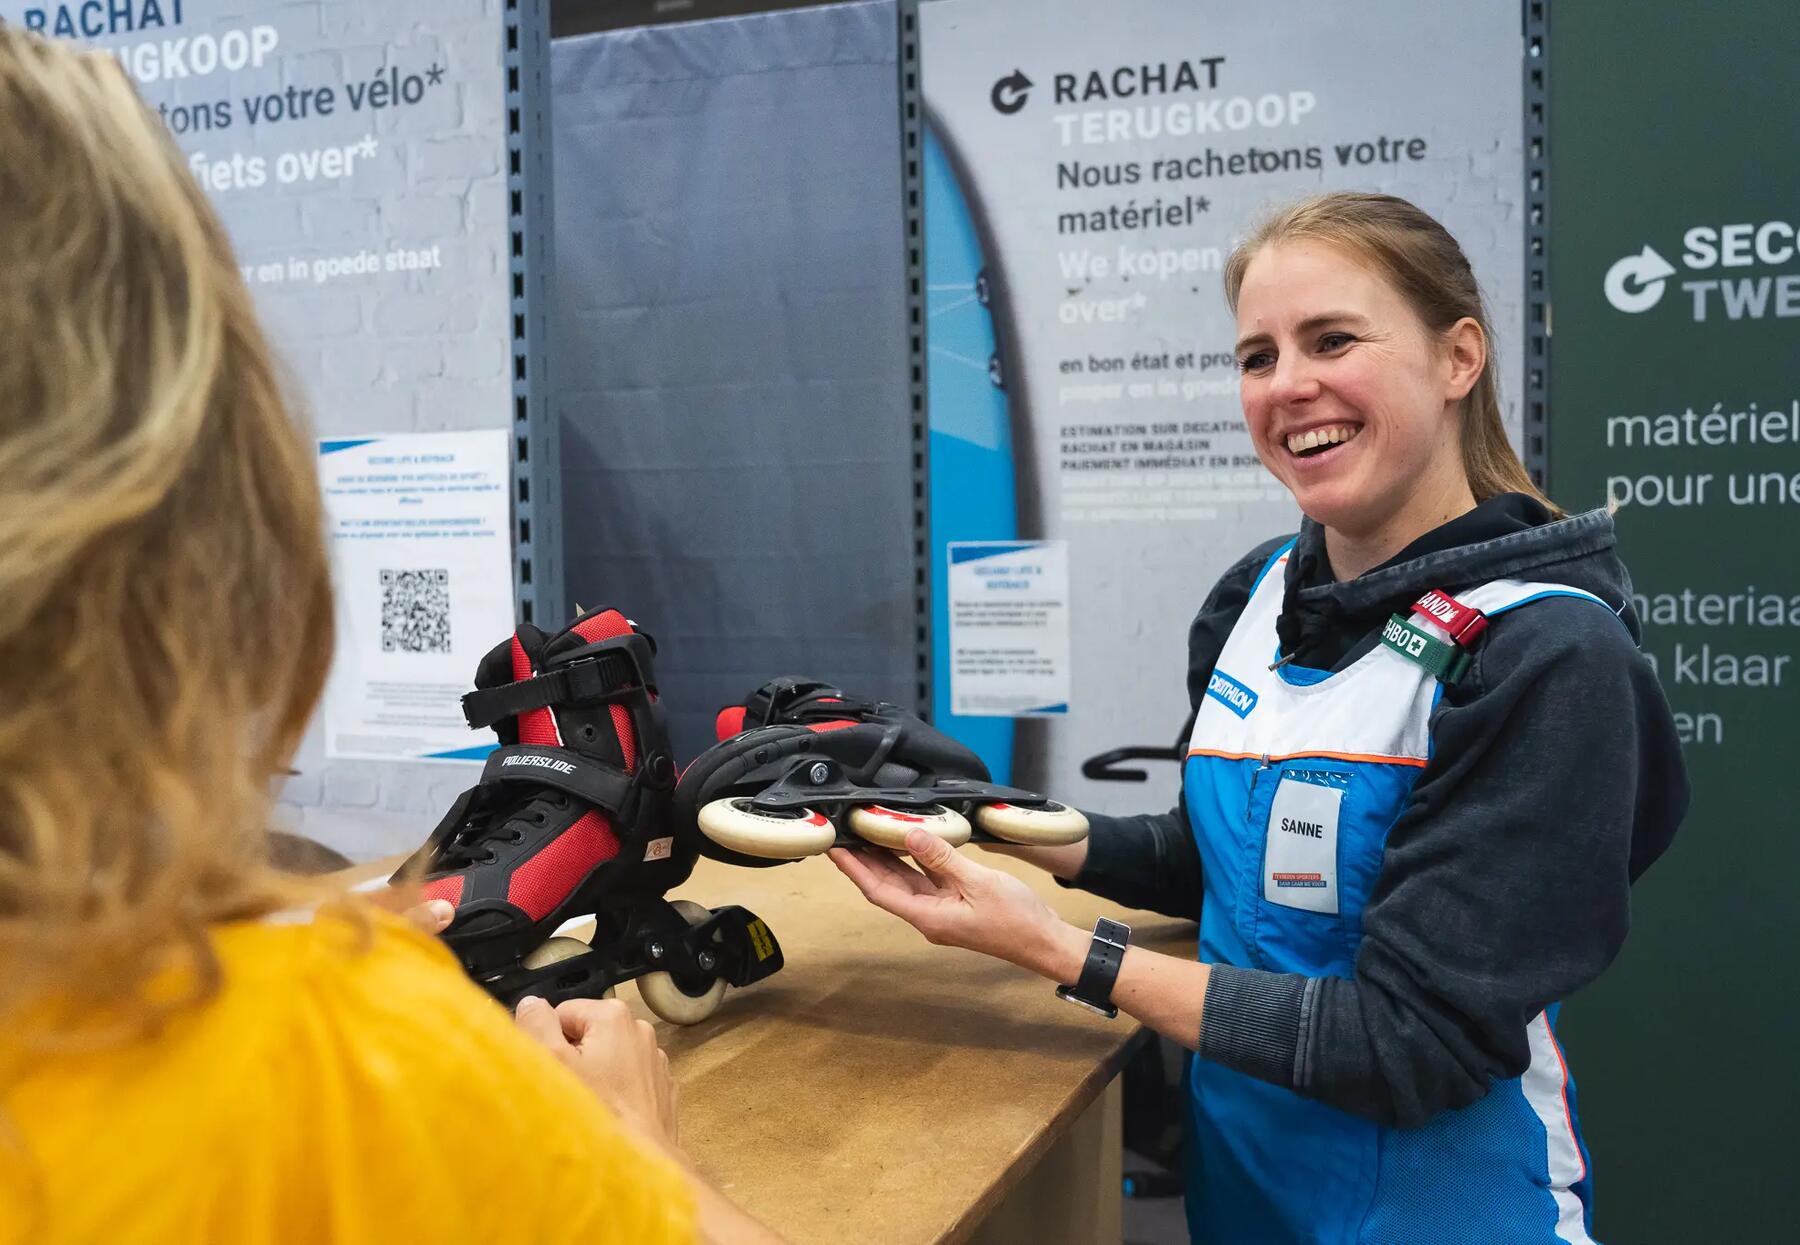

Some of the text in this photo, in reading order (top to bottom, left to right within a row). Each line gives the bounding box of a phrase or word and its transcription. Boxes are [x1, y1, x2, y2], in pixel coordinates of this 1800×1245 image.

[1054, 57, 1226, 105] RACHAT
[243, 85, 335, 125] votre
[1053, 91, 1316, 146] TERUGKOOP
[1057, 135, 1427, 190] Nous rachetons votre
[313, 250, 380, 283] goede
[385, 245, 442, 272] staat
[1058, 245, 1221, 281] We kopen
[1682, 220, 1800, 269] SEC
[1059, 359, 1083, 374] en
[1088, 355, 1125, 373] bon
[1131, 353, 1169, 371] état
[1175, 353, 1194, 368] et
[1606, 473, 1713, 509] pour
[1674, 642, 1791, 686] klaar
[502, 755, 577, 775] POWERSLIDE
[1281, 818, 1323, 839] SANNE
